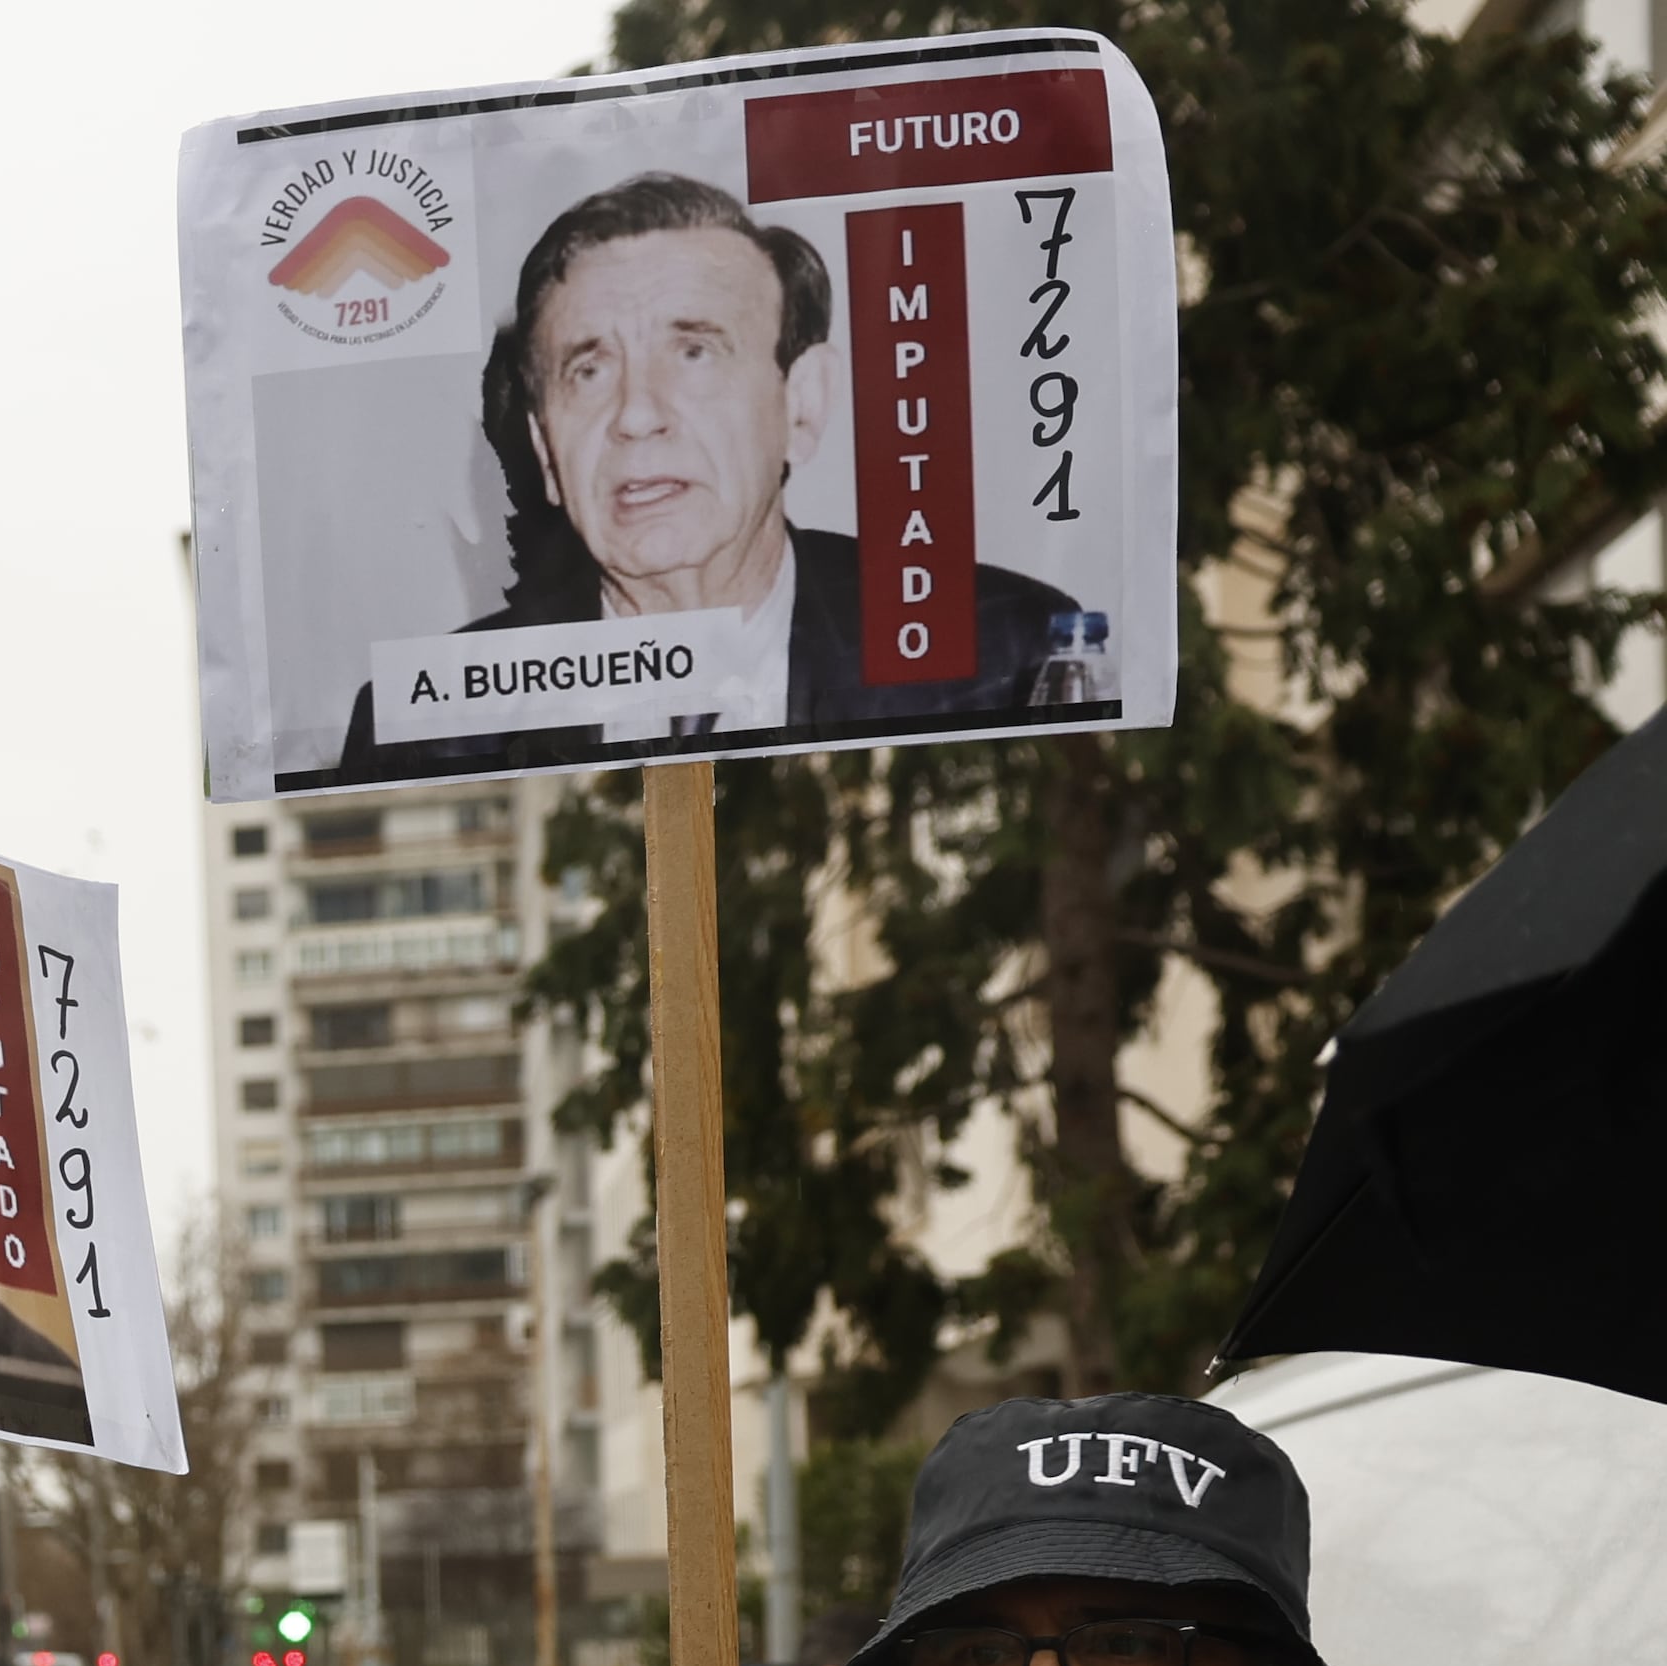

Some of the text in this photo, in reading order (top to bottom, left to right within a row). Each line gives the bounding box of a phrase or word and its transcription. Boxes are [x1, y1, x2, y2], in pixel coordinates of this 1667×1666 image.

[849, 108, 1020, 157] FUTURO
[260, 149, 453, 246] VERDAD Y JUSTICIA
[334, 297, 389, 327] 7291
[1014, 187, 1081, 520] 7291
[888, 229, 933, 660] IMPUTADO
[410, 640, 694, 705] A. BURGUEÑO
[38, 944, 111, 1318] 7291
[1017, 1432, 1226, 1509] UFV
